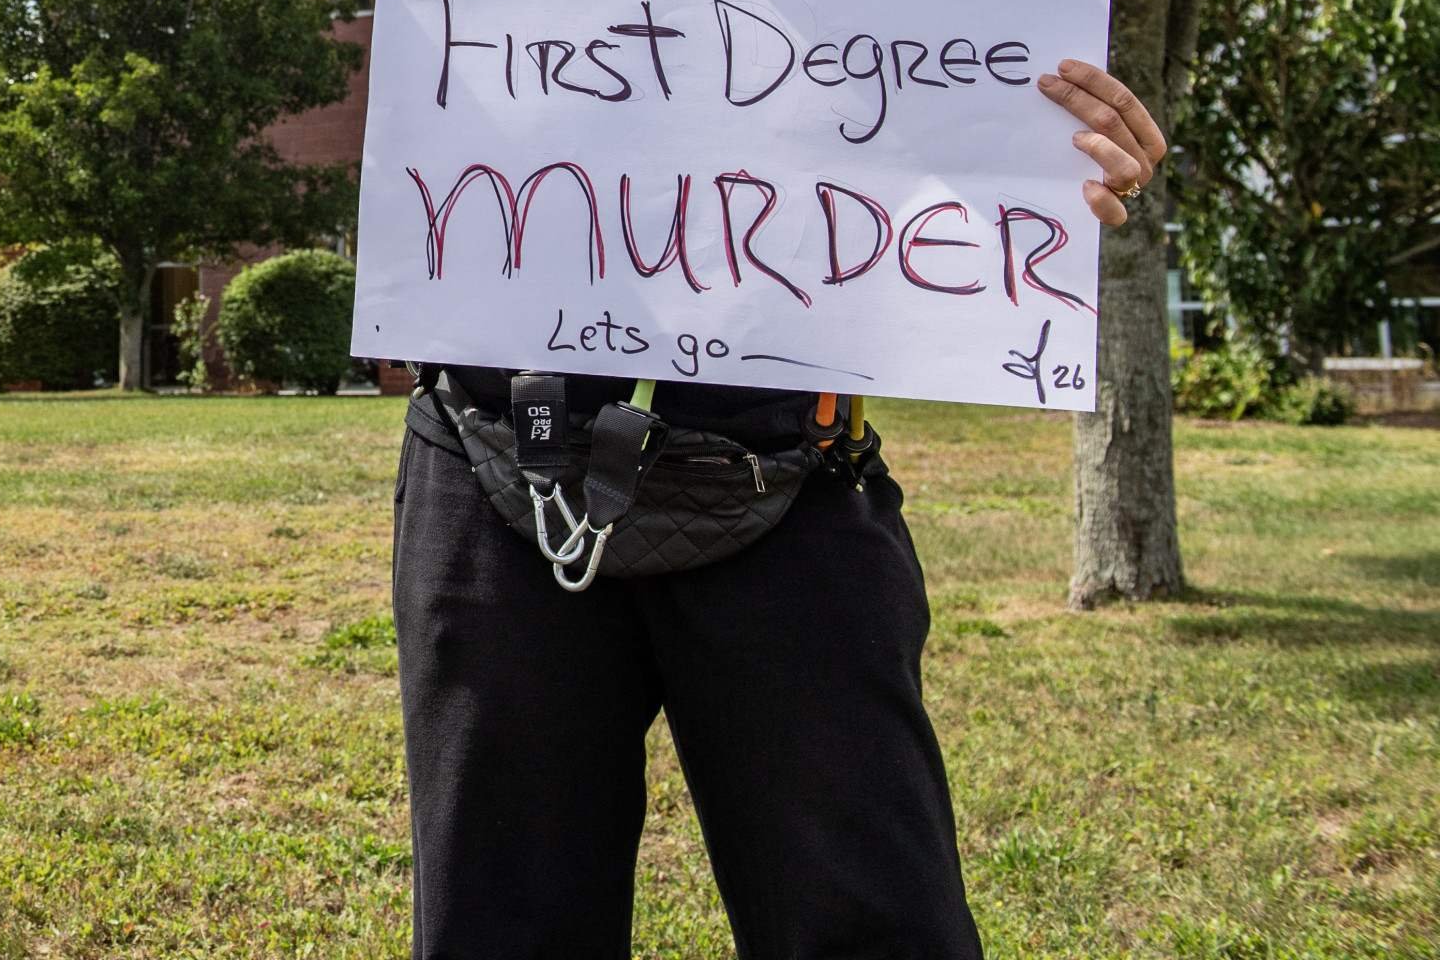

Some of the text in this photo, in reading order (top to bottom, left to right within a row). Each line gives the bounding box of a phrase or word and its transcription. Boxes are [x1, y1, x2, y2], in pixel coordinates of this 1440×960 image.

[405, 161, 1098, 316] MURDER
[547, 308, 731, 378] Lets go
[528, 406, 551, 417] 50
[532, 418, 552, 426] PRO
